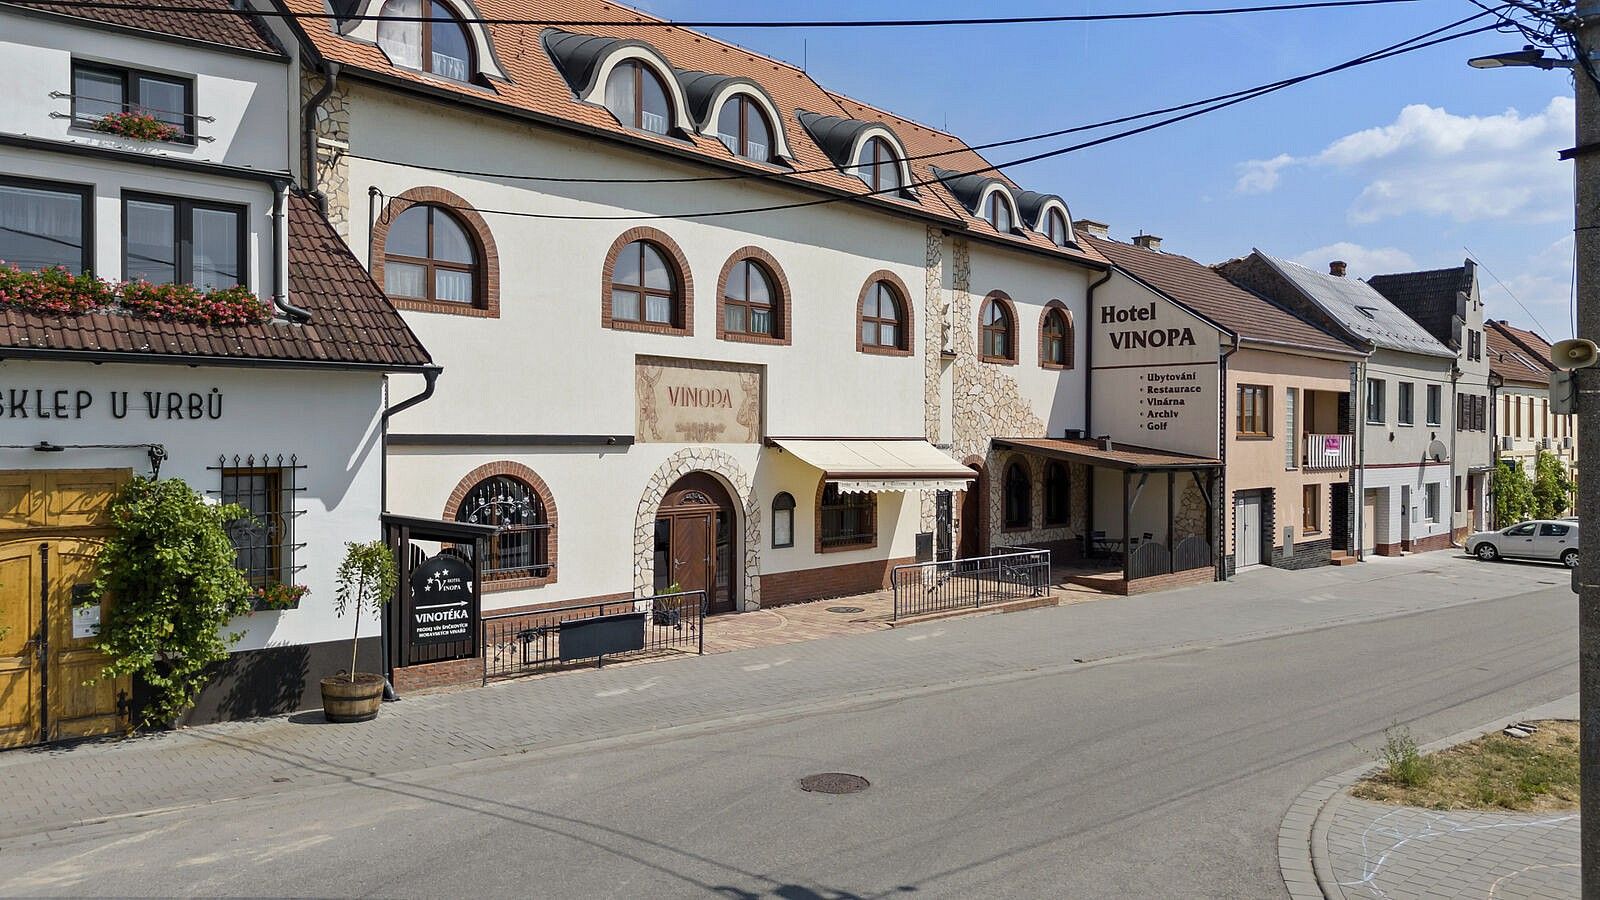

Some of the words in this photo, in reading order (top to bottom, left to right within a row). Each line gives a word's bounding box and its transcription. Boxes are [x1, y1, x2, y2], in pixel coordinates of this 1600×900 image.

[1101, 302, 1156, 323] Hotel
[1109, 328, 1196, 349] VINOPA
[1147, 372, 1196, 383] Ubytování
[1147, 386, 1201, 394] Restaurace
[668, 386, 733, 408] VINOPA
[1147, 398, 1185, 406] Vinárna
[111, 391, 128, 418] U
[143, 388, 223, 419] VRBŮ
[1147, 410, 1179, 418] Archiv
[1147, 422, 1167, 430] Golf
[415, 609, 469, 623] VINOTÉKA
